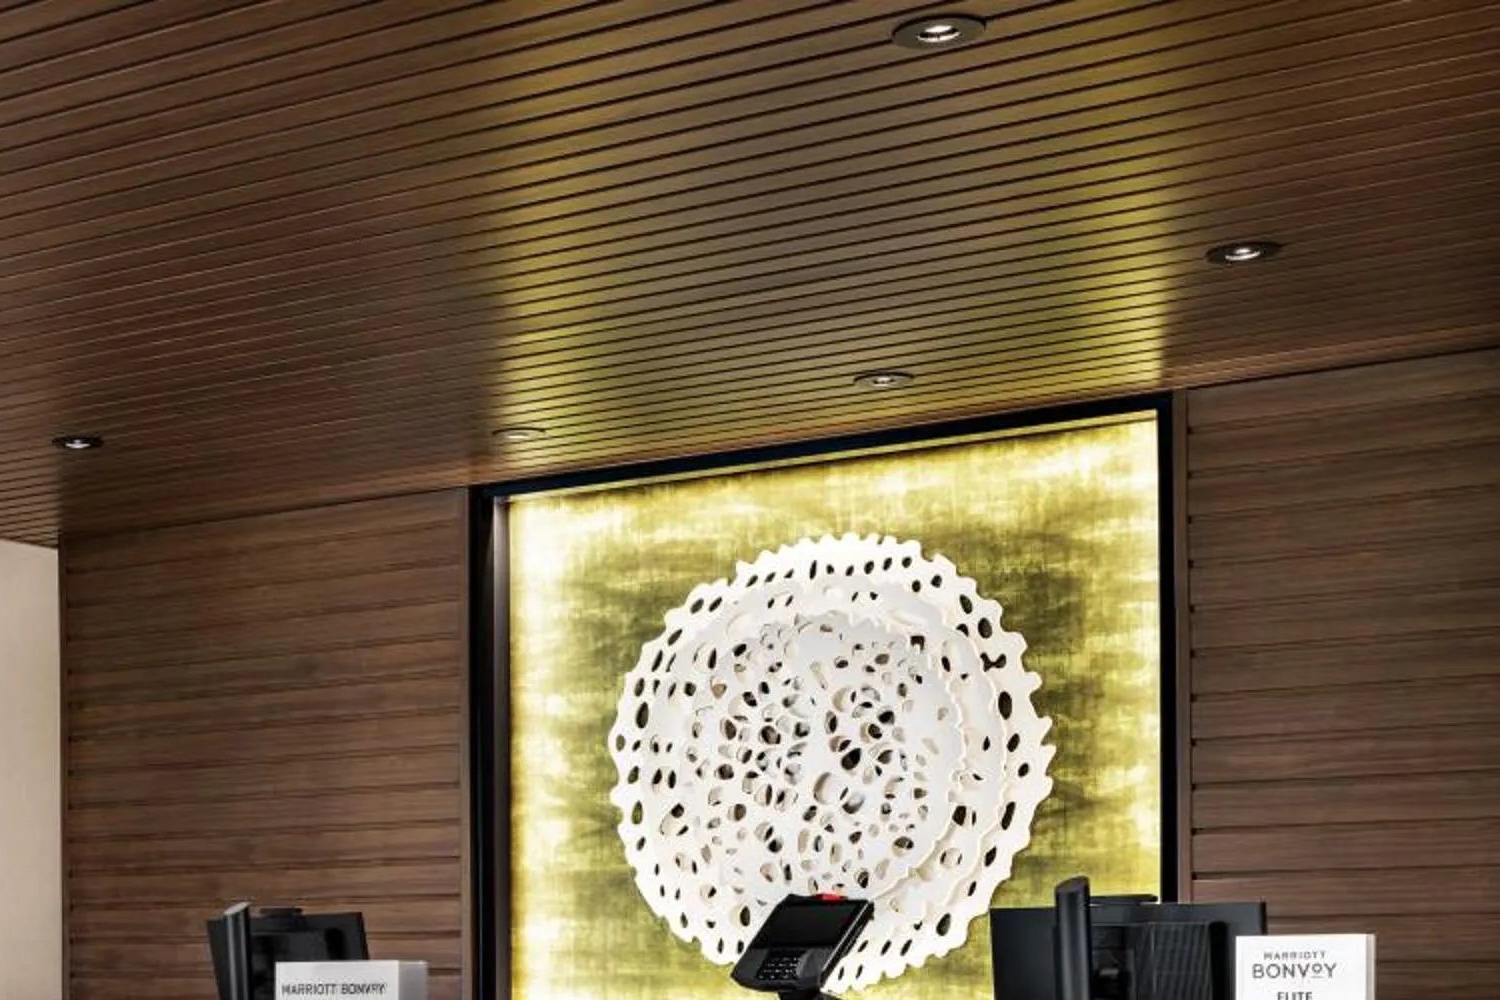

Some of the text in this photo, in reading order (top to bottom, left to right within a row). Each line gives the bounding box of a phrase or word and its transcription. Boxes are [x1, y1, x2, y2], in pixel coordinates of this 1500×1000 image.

[1263, 951, 1326, 961] MARRIOTT
[1252, 962, 1337, 979] BONVOY
[282, 983, 337, 996] MARRIOTT
